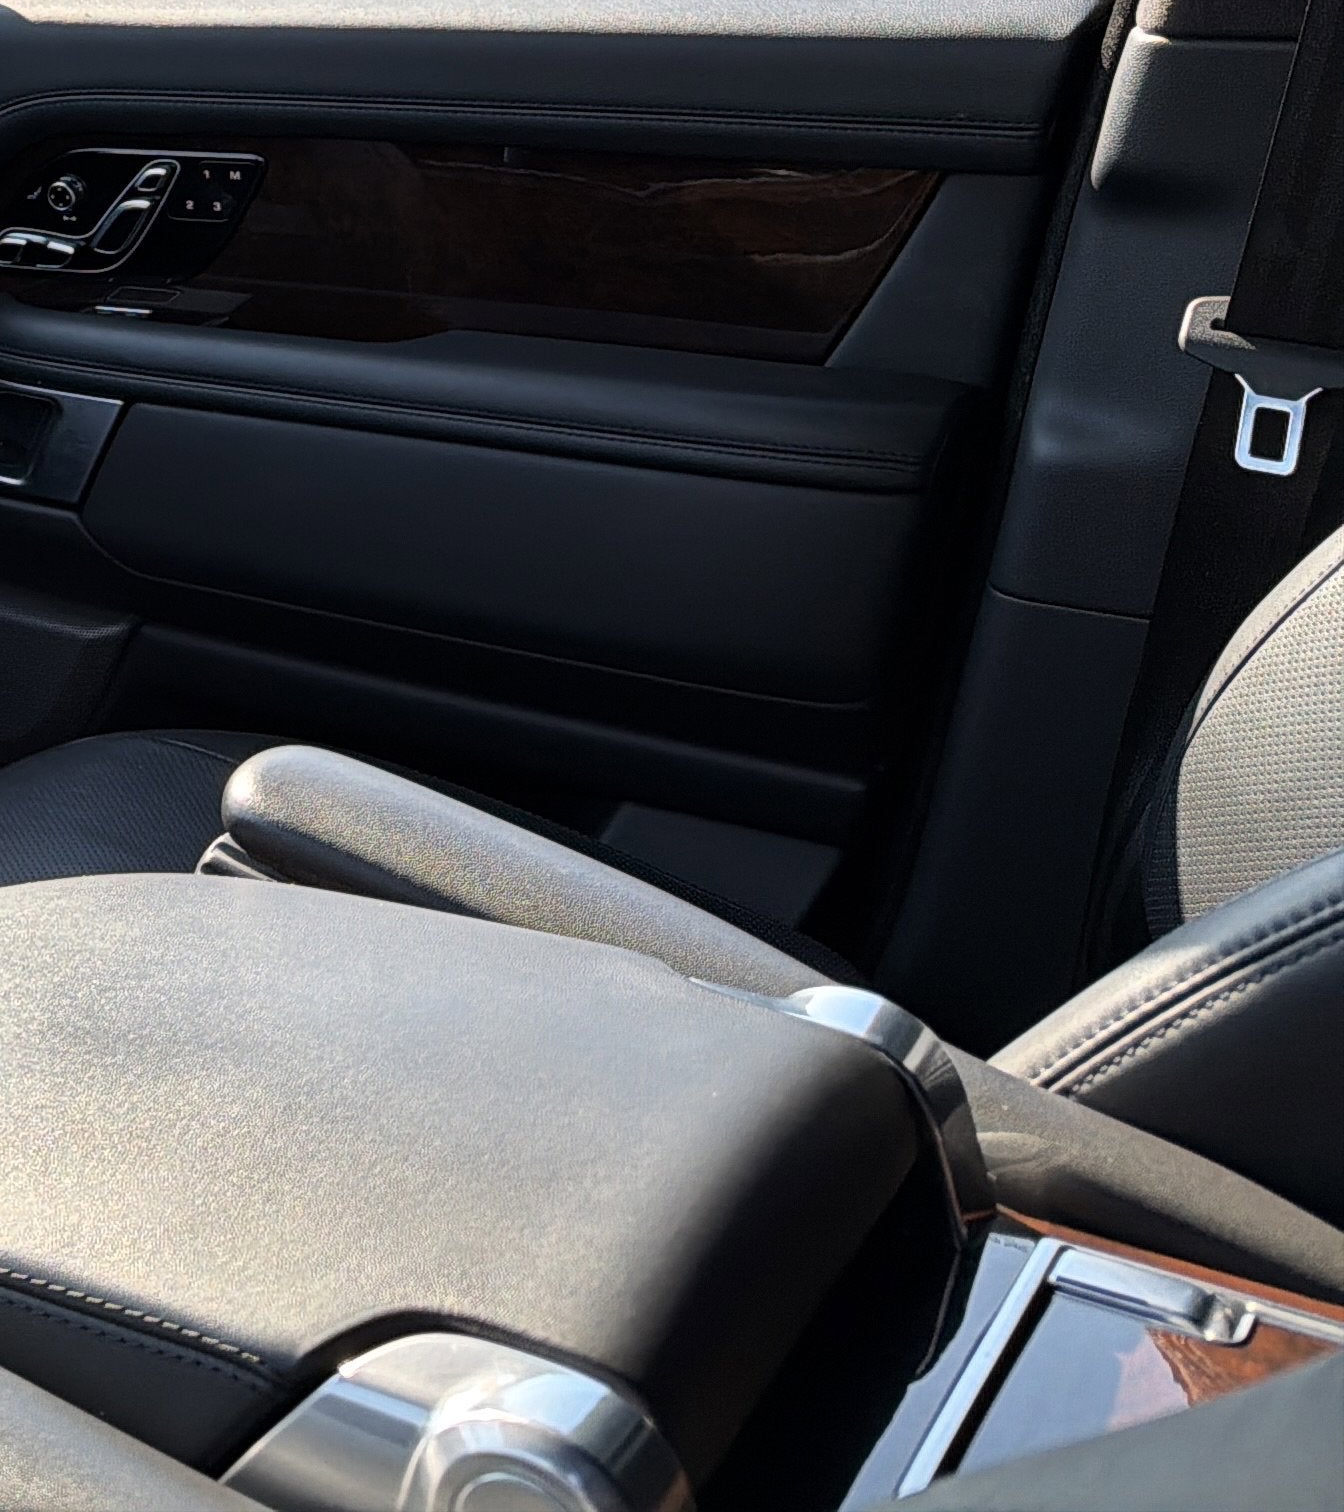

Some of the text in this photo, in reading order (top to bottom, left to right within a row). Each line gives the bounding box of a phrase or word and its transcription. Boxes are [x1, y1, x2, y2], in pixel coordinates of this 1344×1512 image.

[203, 169, 210, 180] 1
[229, 170, 241, 180] M
[185, 200, 194, 210] 2
[212, 201, 222, 212] 3
